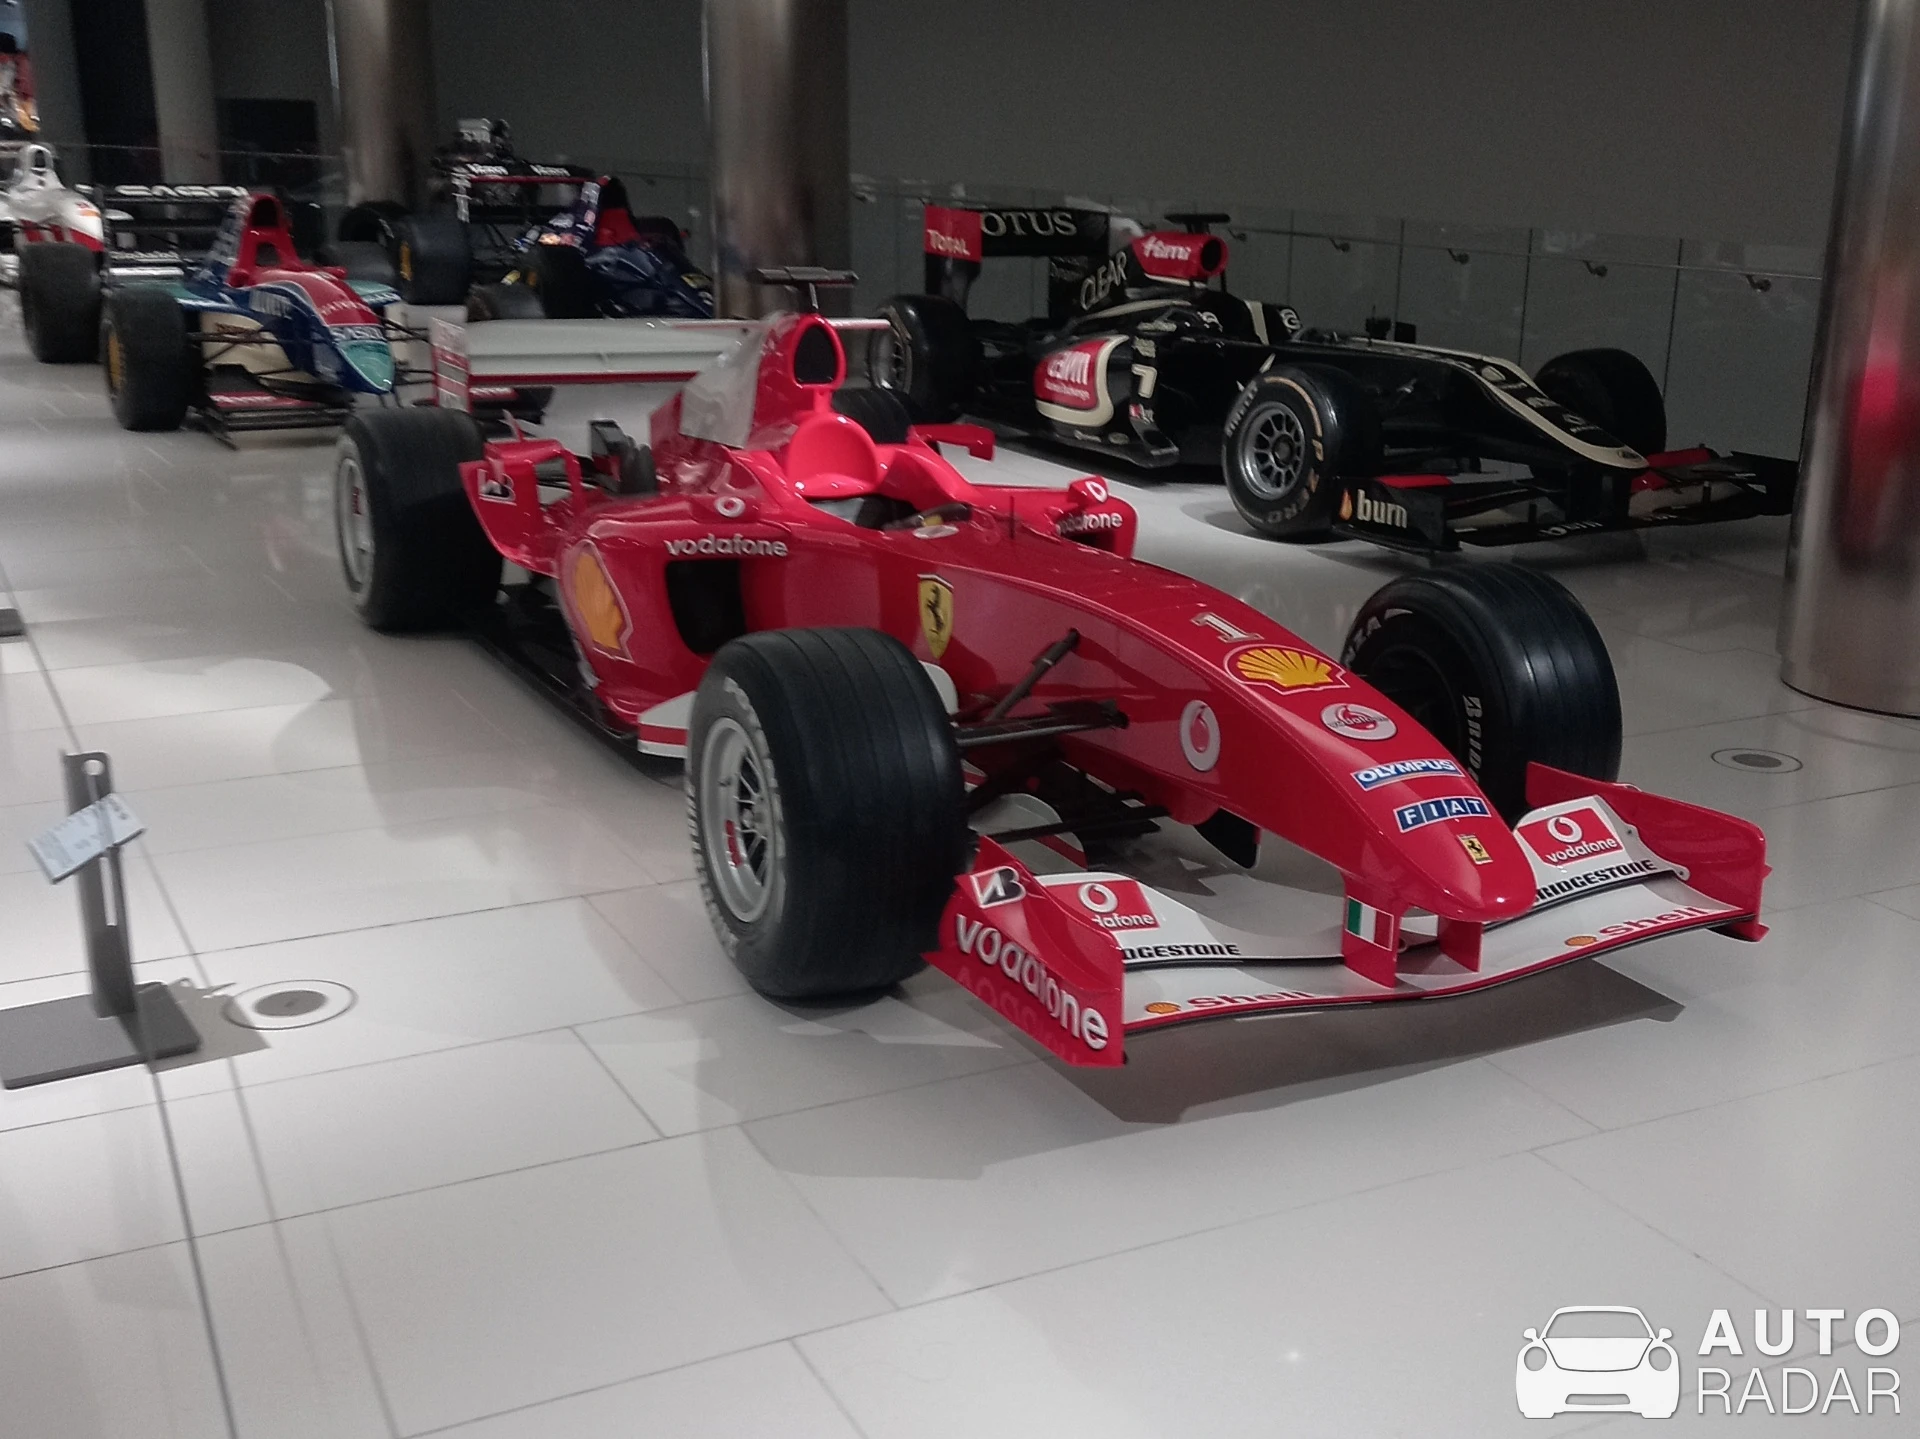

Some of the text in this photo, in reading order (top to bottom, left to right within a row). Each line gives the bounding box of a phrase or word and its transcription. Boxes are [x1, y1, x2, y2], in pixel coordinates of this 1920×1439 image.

[980, 211, 1077, 236] OTUS
[1131, 363, 1158, 398] 7
[1356, 488, 1408, 528] burn
[664, 532, 788, 556] vodafone
[1190, 612, 1265, 644] 1
[1357, 759, 1456, 784] OLYMPUS
[1404, 799, 1486, 829] FIAT
[1546, 838, 1618, 863] vodafone
[1600, 907, 1708, 936] Shell
[1187, 990, 1313, 1008] Shell
